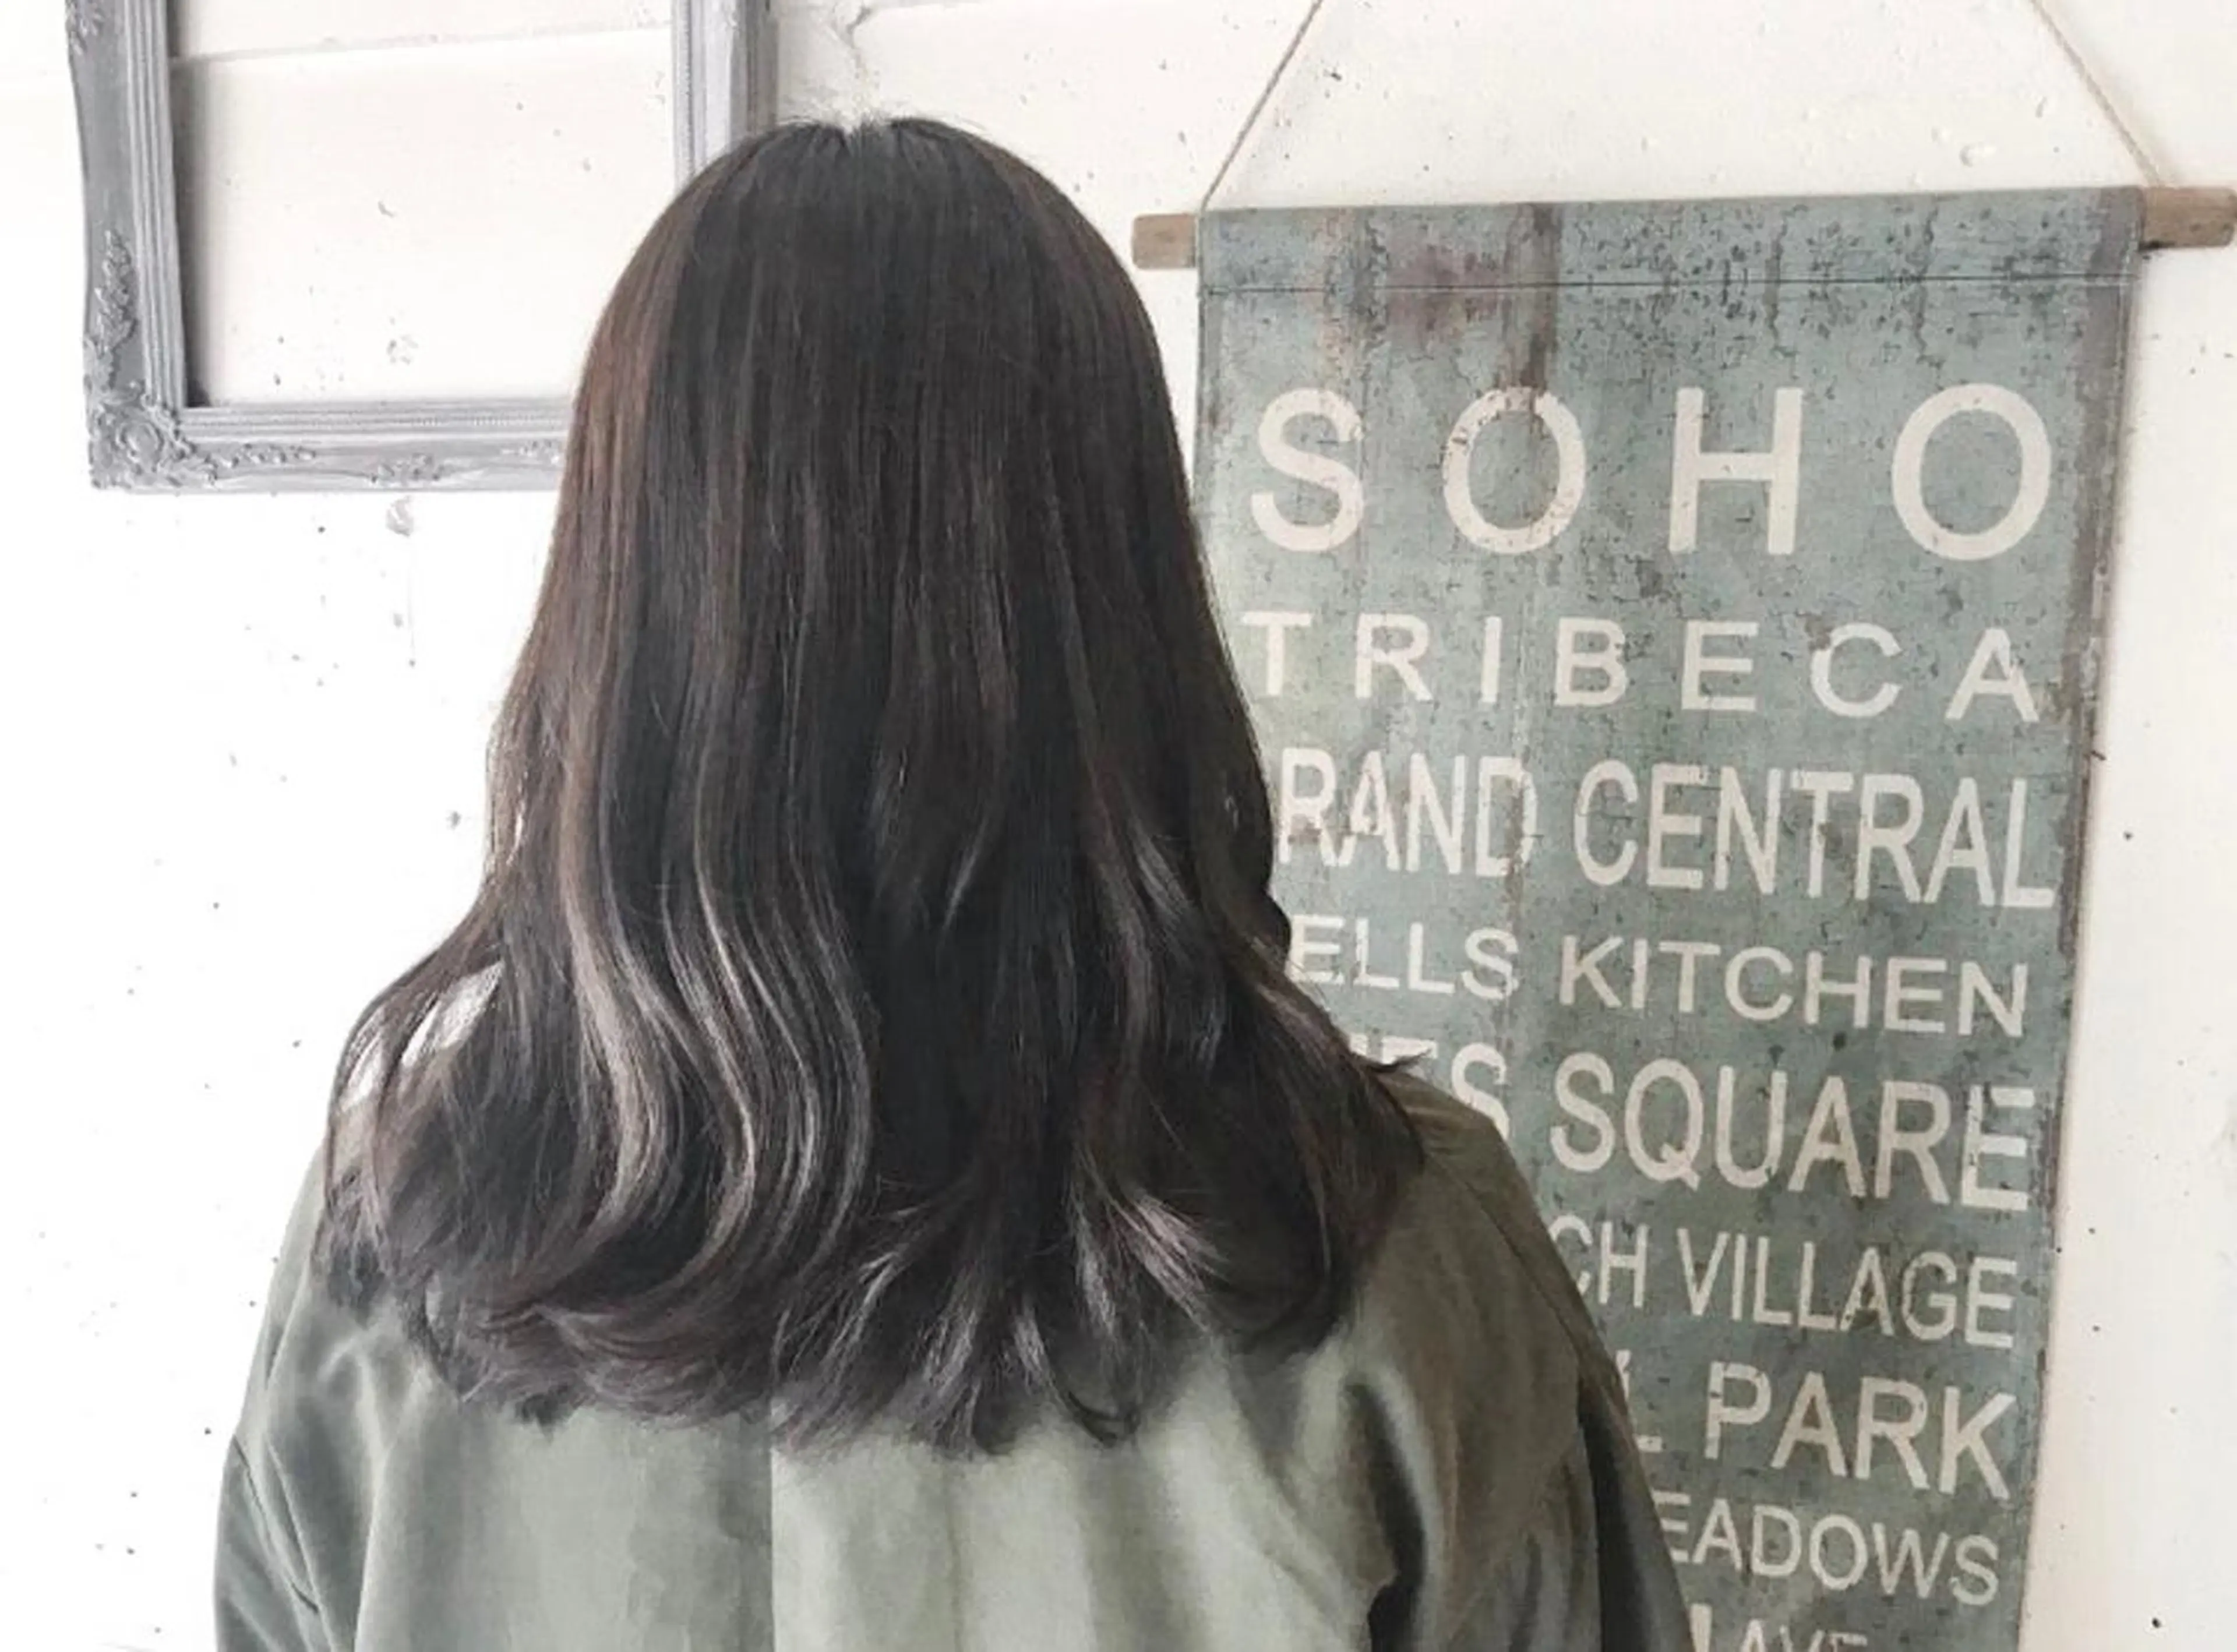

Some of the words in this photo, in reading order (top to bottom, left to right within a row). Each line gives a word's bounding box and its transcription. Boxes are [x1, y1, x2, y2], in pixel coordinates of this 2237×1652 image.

[1249, 382, 2053, 562] SOHO
[1242, 610, 2039, 723] TRIBECA
[1279, 747, 1538, 877] RAND
[1574, 760, 2055, 910] CENTRAL
[1284, 913, 1519, 1000] ELLS
[1558, 934, 2028, 1037] KITCHEN
[1548, 1052, 2035, 1212] SQUARE
[1677, 1227, 2018, 1349] VILLAGE
[1703, 1360, 2016, 1501] PARK
